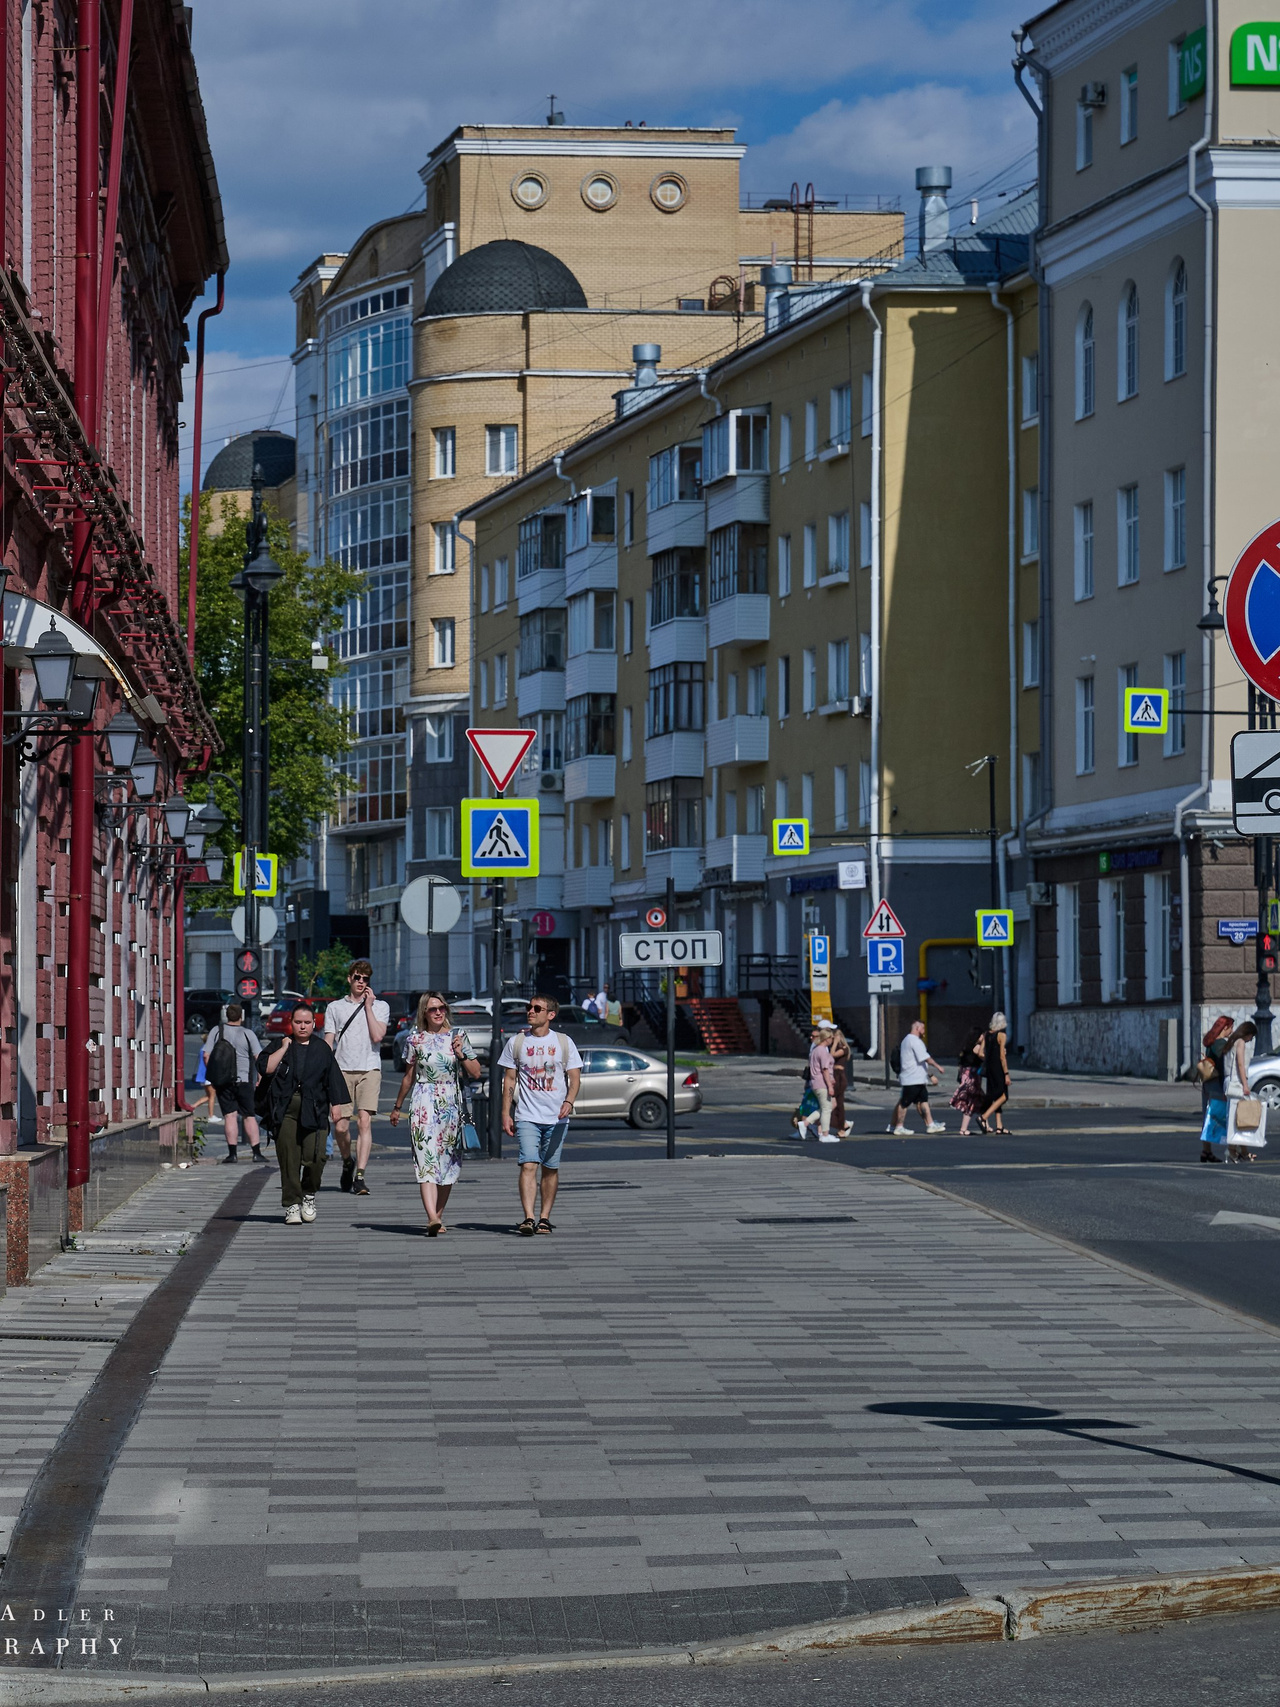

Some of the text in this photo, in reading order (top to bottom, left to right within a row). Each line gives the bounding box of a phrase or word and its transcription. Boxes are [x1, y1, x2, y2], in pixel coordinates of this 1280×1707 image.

[1184, 42, 1202, 86] NS
[1246, 34, 1280, 72] N
[634, 938, 707, 961] СТОП
[815, 938, 825, 961] P
[877, 943, 897, 971] P
[241, 979, 258, 996] 32
